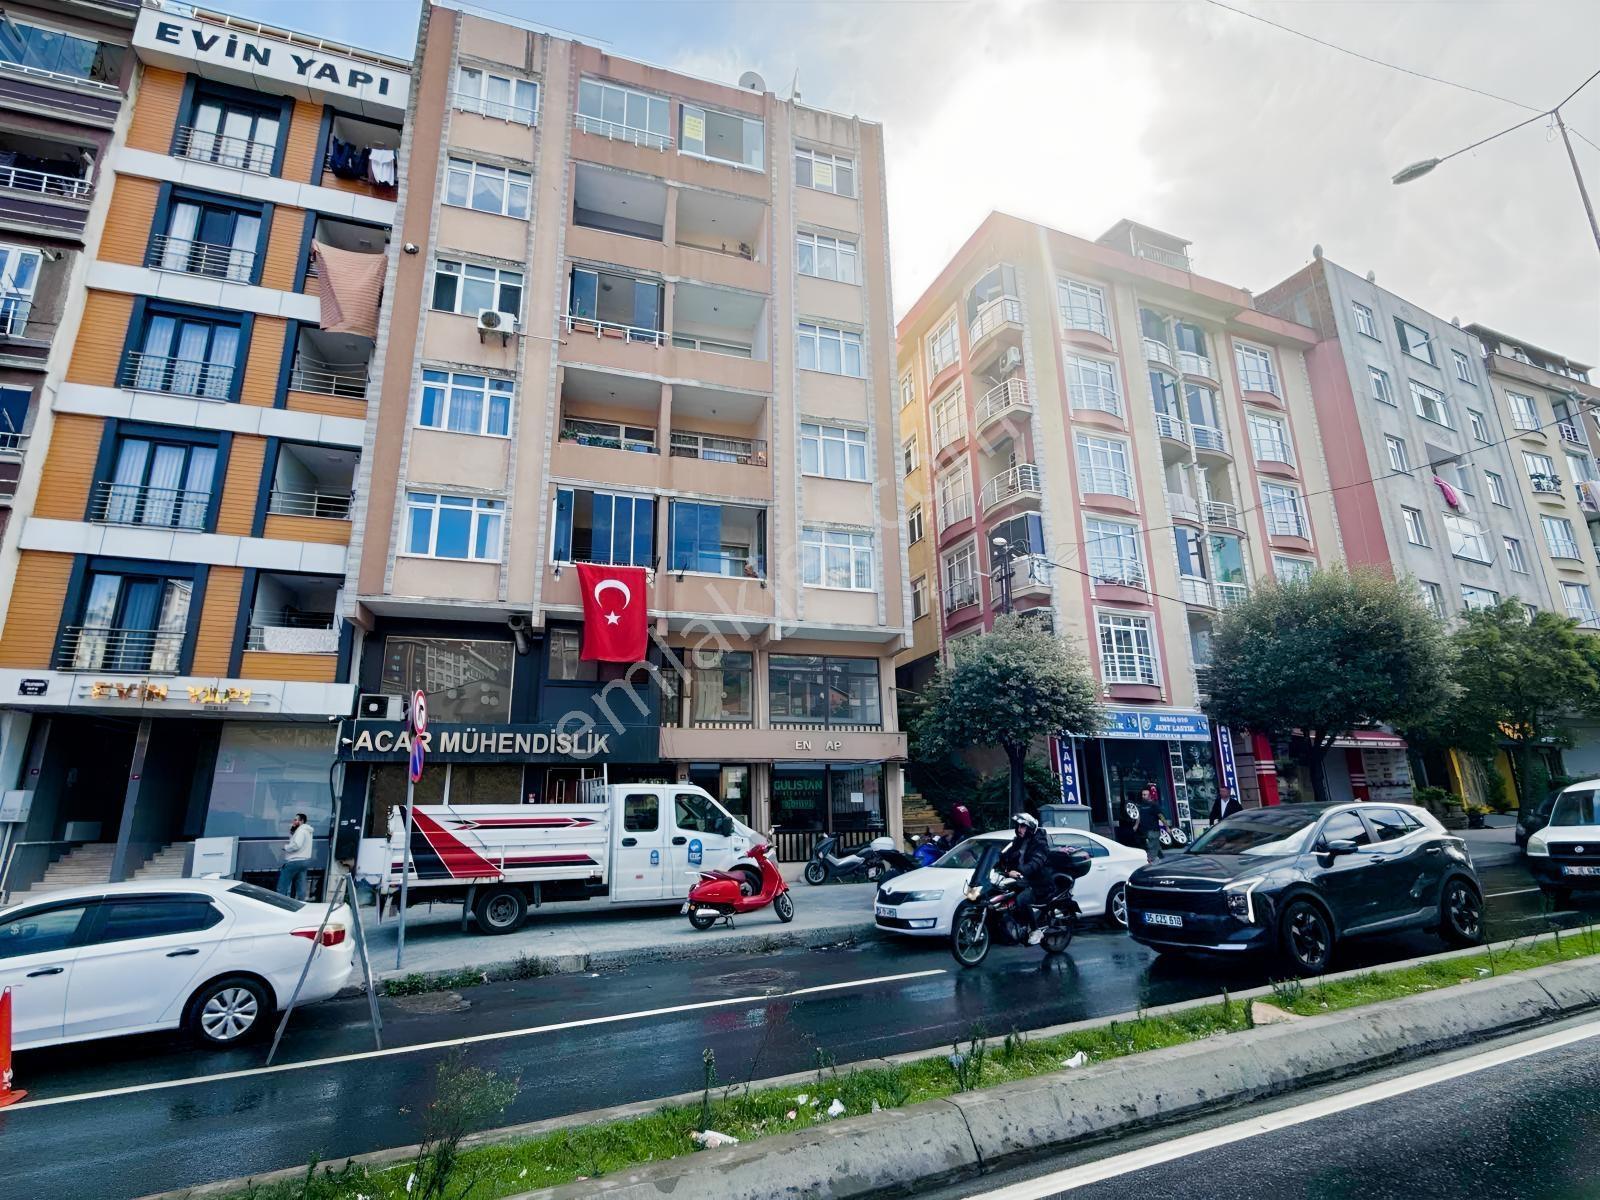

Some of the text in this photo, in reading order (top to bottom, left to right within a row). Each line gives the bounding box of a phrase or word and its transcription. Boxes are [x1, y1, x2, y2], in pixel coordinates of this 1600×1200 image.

[155, 21, 389, 95] EVİN YAPI
[353, 727, 611, 754] ACAR MÜHENDİSLİK
[795, 740, 812, 751] EN
